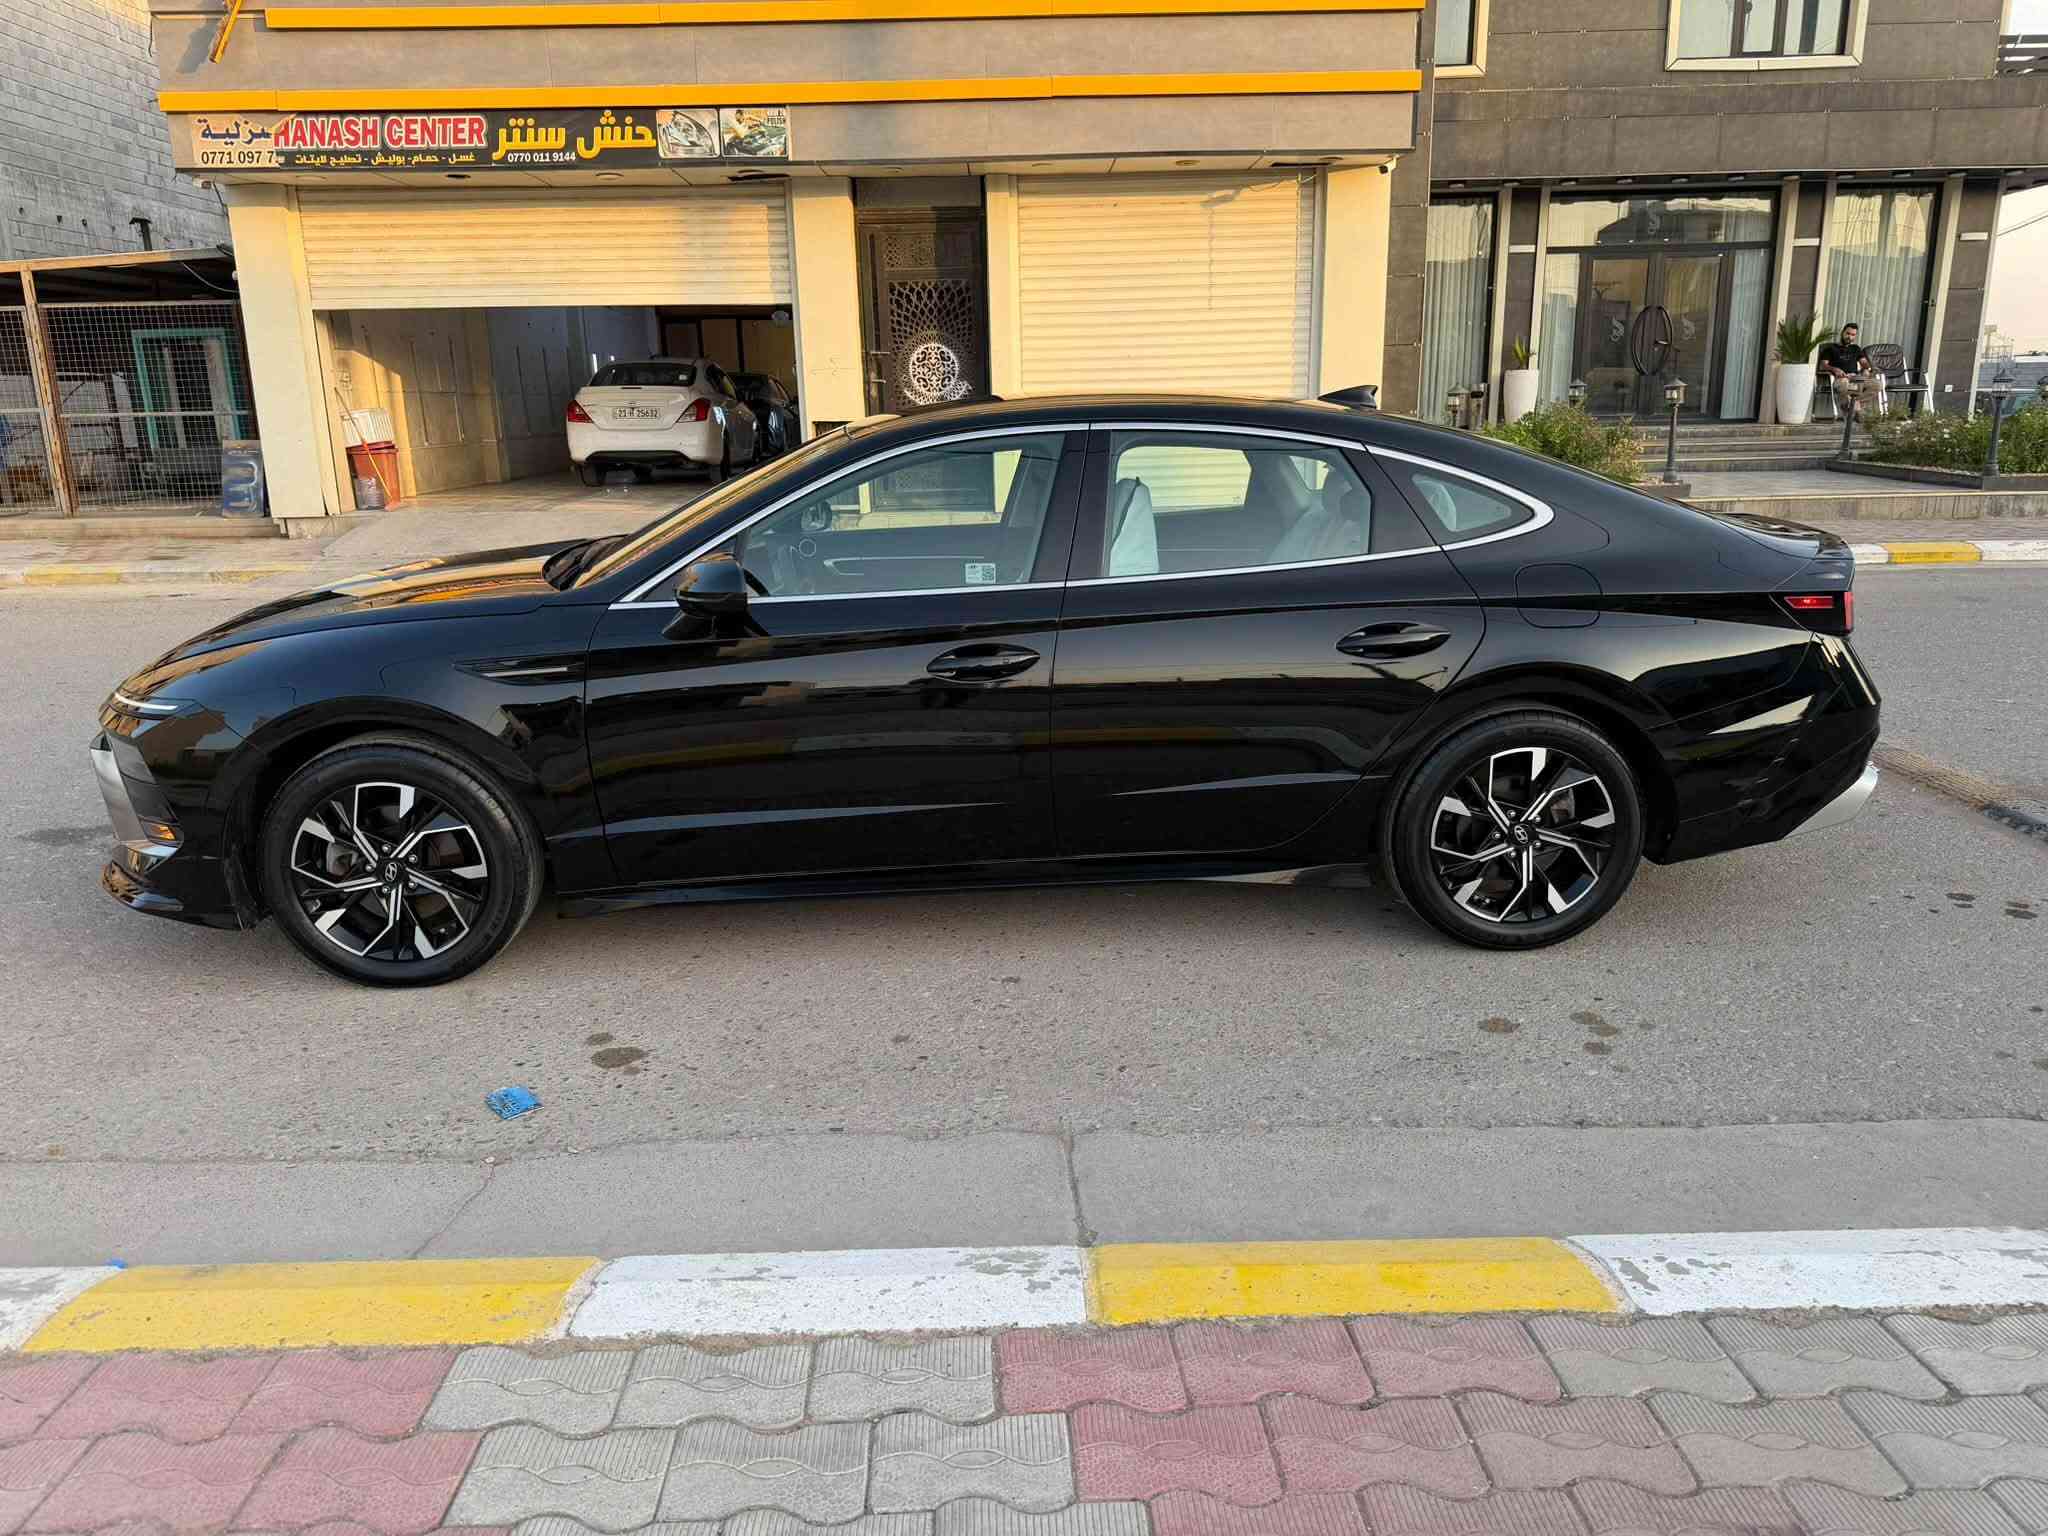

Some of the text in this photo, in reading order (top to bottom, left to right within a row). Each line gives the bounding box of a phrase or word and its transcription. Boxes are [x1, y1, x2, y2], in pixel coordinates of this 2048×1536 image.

[273, 115, 487, 149] HANASH CENTER
[492, 110, 657, 161] حنش سنتر
[201, 151, 234, 165] 0771
[238, 151, 262, 164] 097
[329, 153, 362, 167] تصليح
[371, 152, 406, 166] بوليش
[411, 153, 440, 166] حمام
[448, 152, 476, 164] غسل
[507, 151, 576, 163] 0770 011 9144
